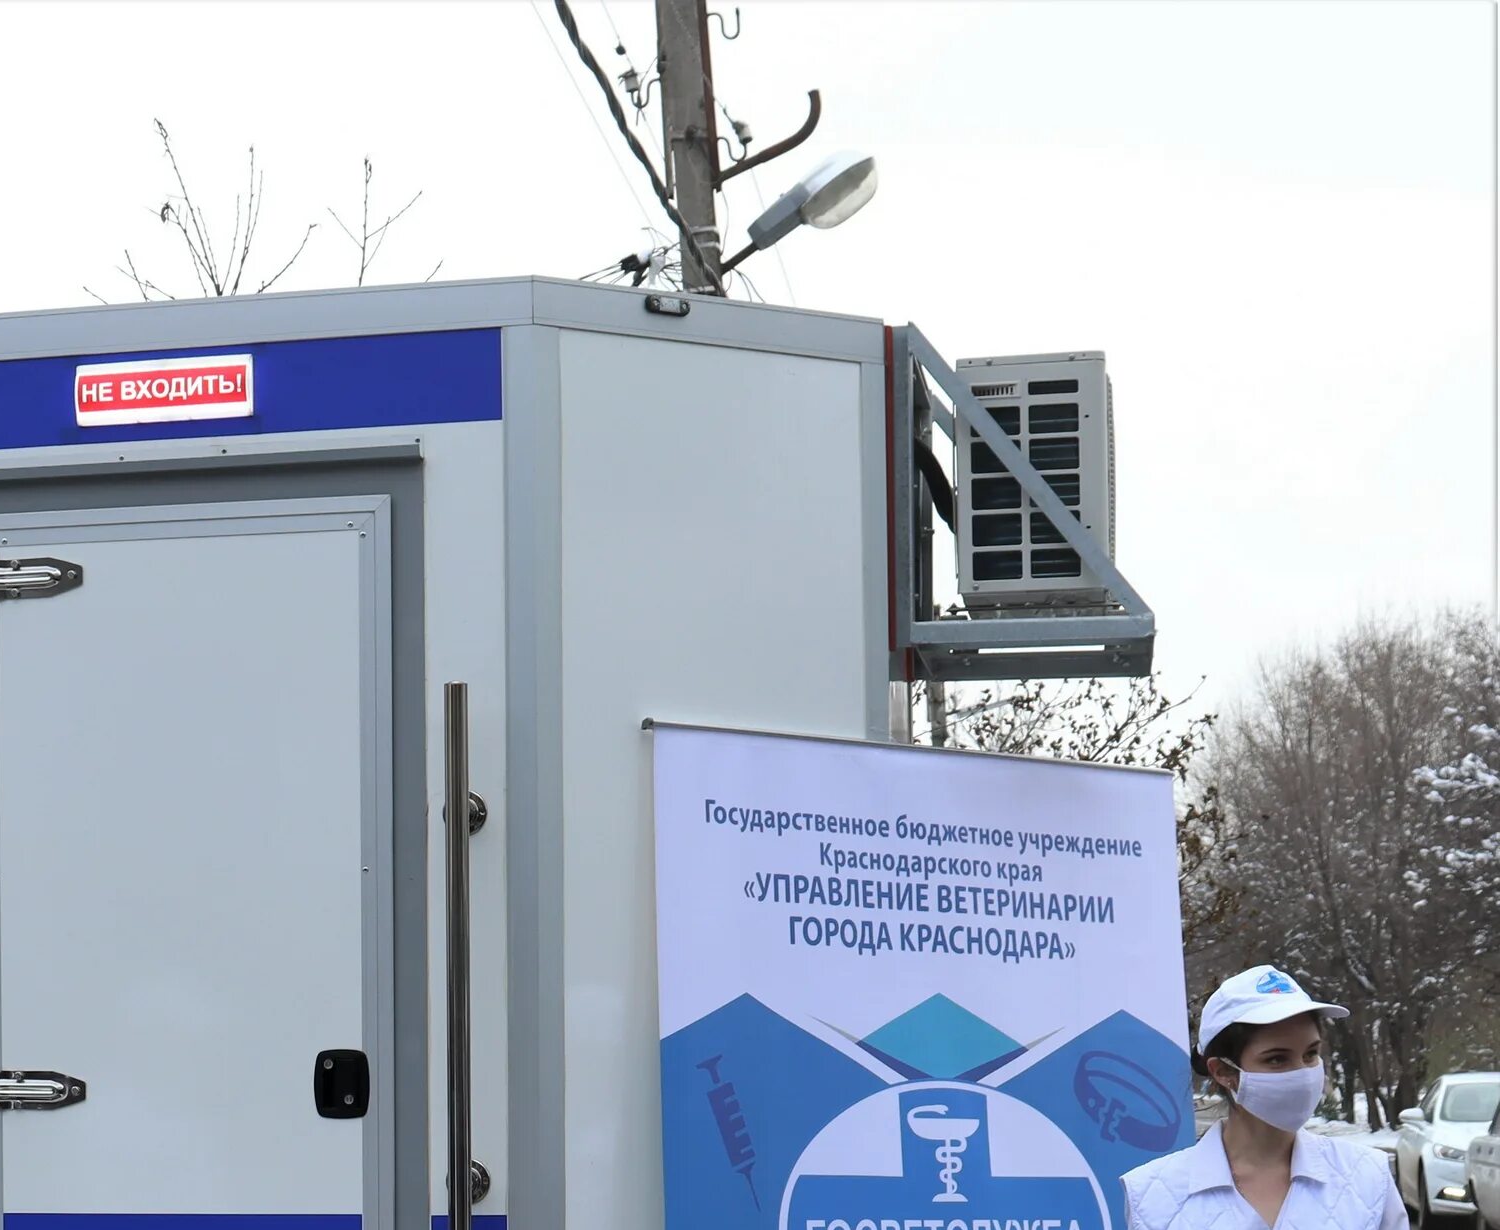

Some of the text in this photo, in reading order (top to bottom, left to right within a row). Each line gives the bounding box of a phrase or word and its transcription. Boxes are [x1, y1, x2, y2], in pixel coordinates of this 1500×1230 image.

[81, 373, 242, 404] НЕ ВХОДИТЬ!
[705, 798, 1142, 859] Государственное бюджетное учреждение
[819, 842, 1043, 884] Краснодарского края
[742, 870, 1115, 924] «УПРАВЛЕНИЕ ВЕТЕРИНАРИИ
[789, 915, 1076, 964] ГОРОДА КРАСНОДАРА»
